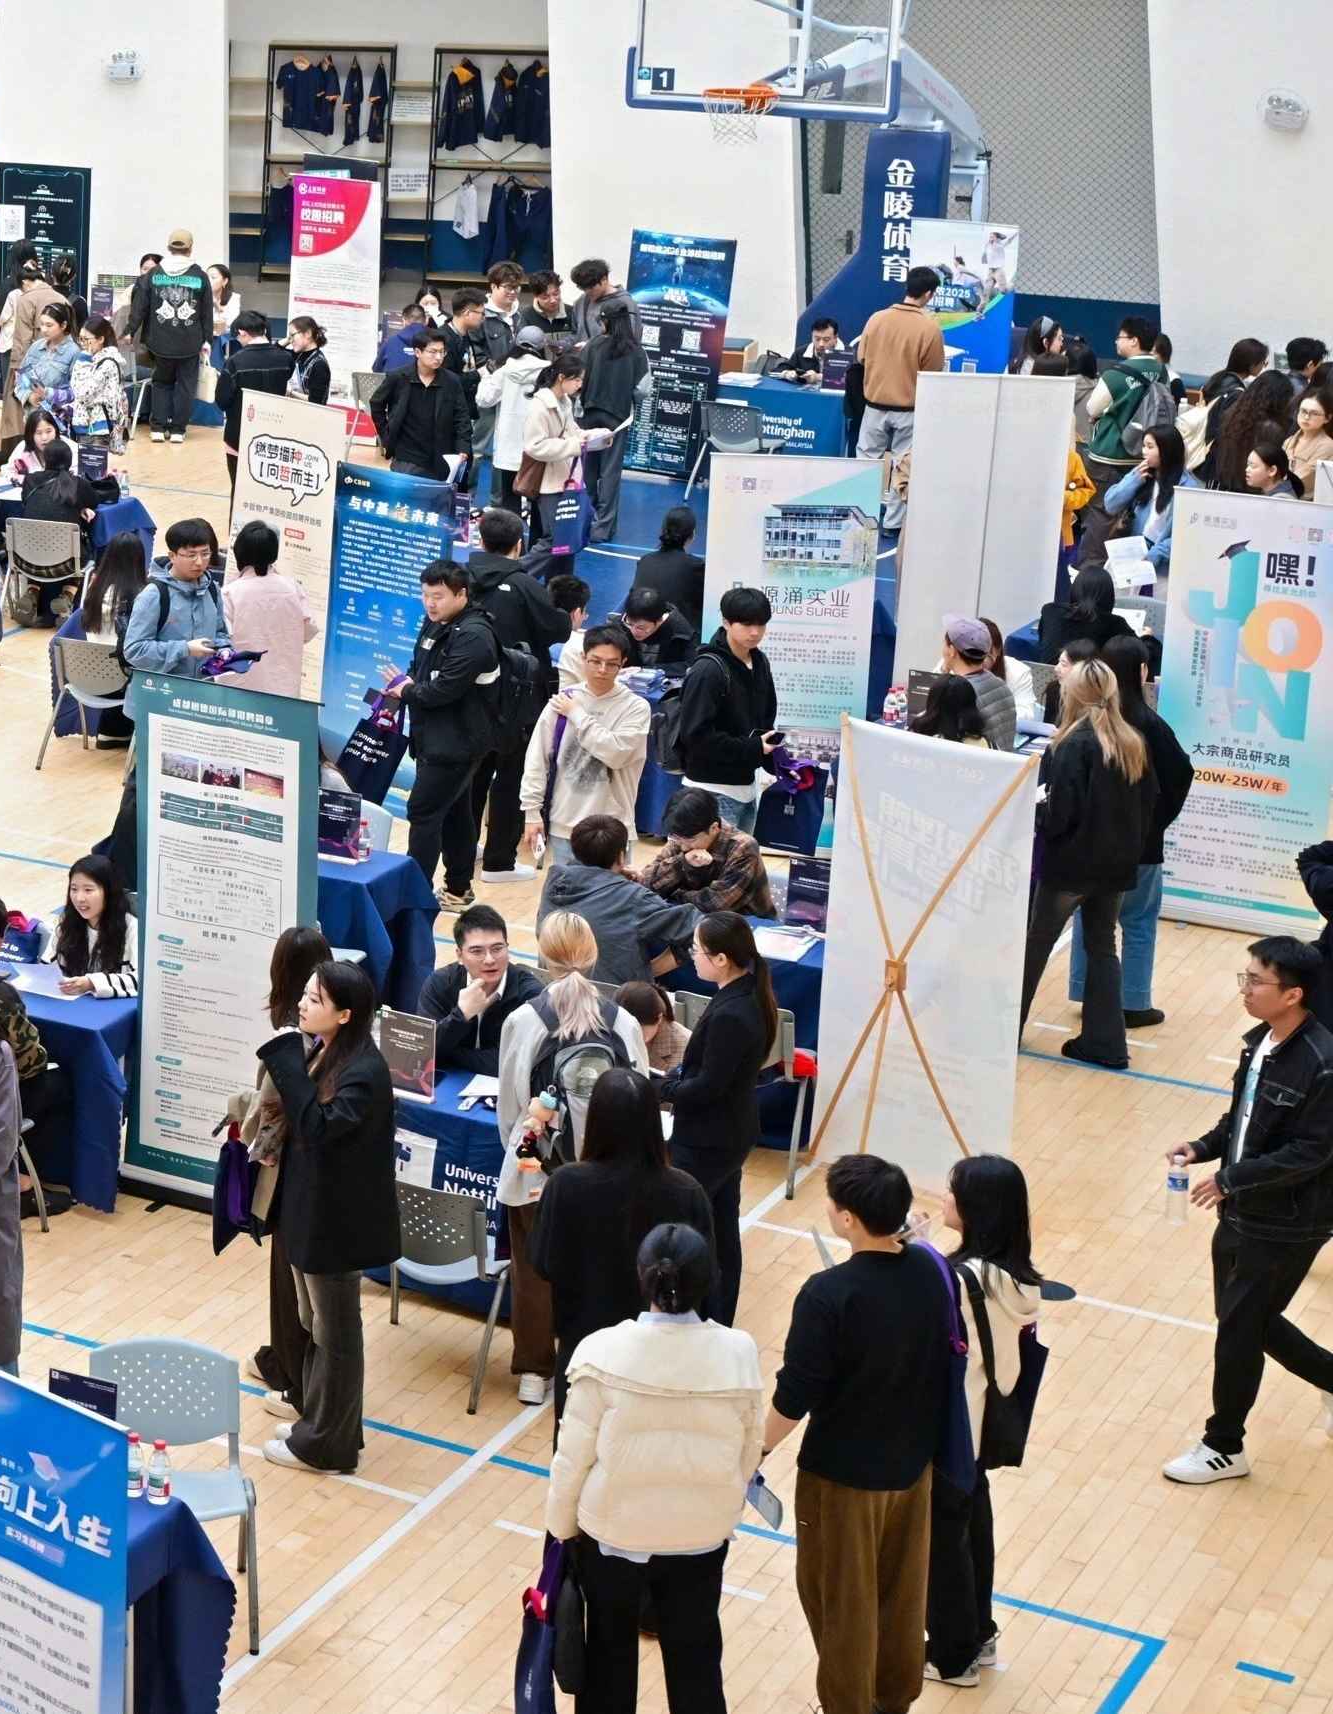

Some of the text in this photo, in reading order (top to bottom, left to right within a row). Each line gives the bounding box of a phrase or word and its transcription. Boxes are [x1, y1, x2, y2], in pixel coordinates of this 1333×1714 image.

[659, 69, 669, 88] 1
[882, 158, 916, 283] 金陵体育
[762, 425, 815, 441] ottingham
[793, 418, 802, 426] of
[255, 439, 303, 465] 燃梦播种
[806, 606, 850, 619] SURGE
[1192, 743, 1291, 768] 大宗商品研究员
[445, 1162, 499, 1188] Univers
